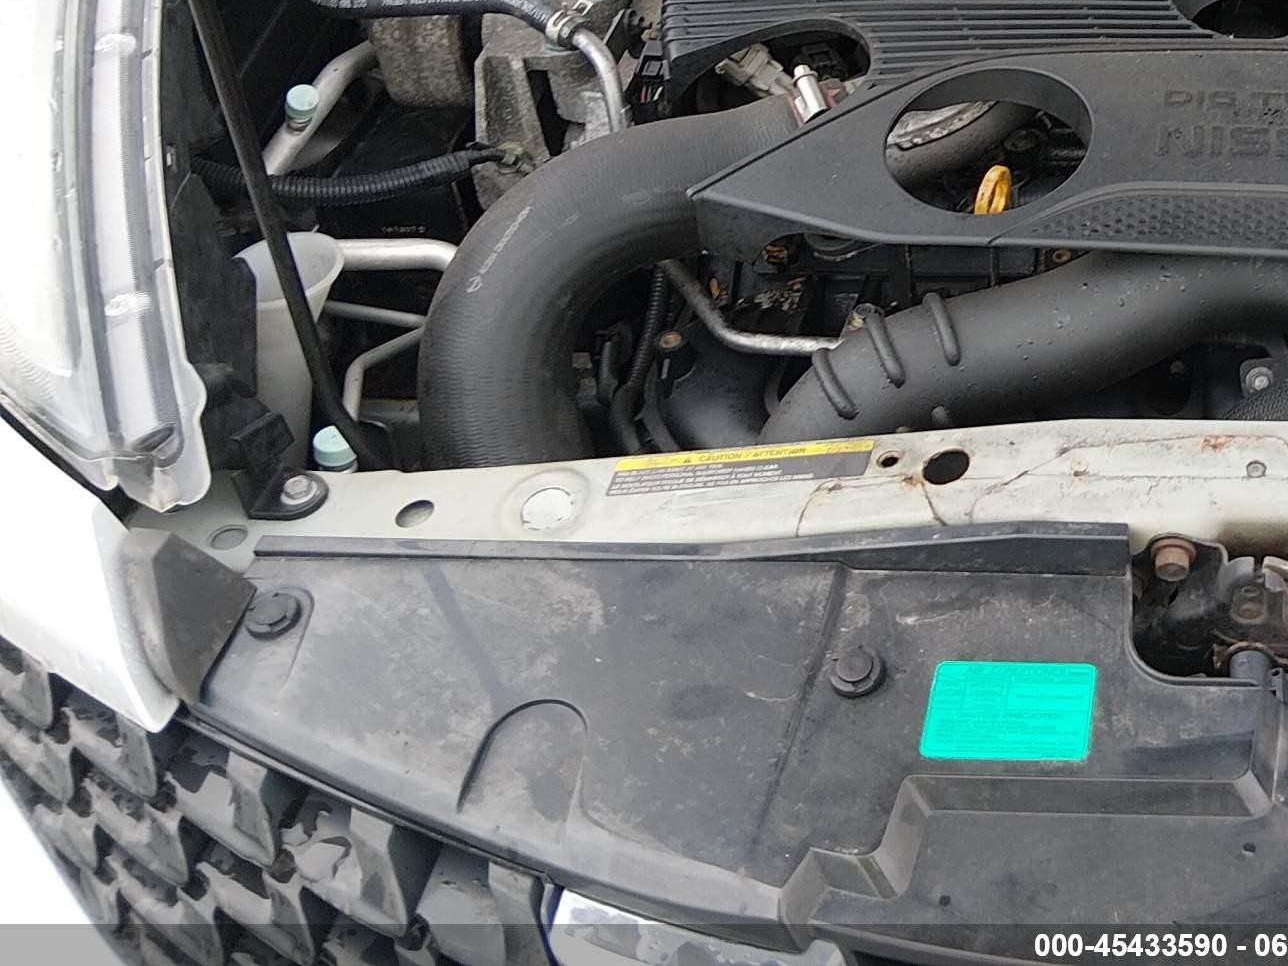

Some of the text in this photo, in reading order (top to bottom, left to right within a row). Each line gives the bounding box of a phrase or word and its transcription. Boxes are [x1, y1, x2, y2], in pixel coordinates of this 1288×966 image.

[699, 452, 742, 462] CAUTION
[752, 447, 806, 458] ATTENTION
[966, 666, 1067, 676] AIR CONDITIONER
